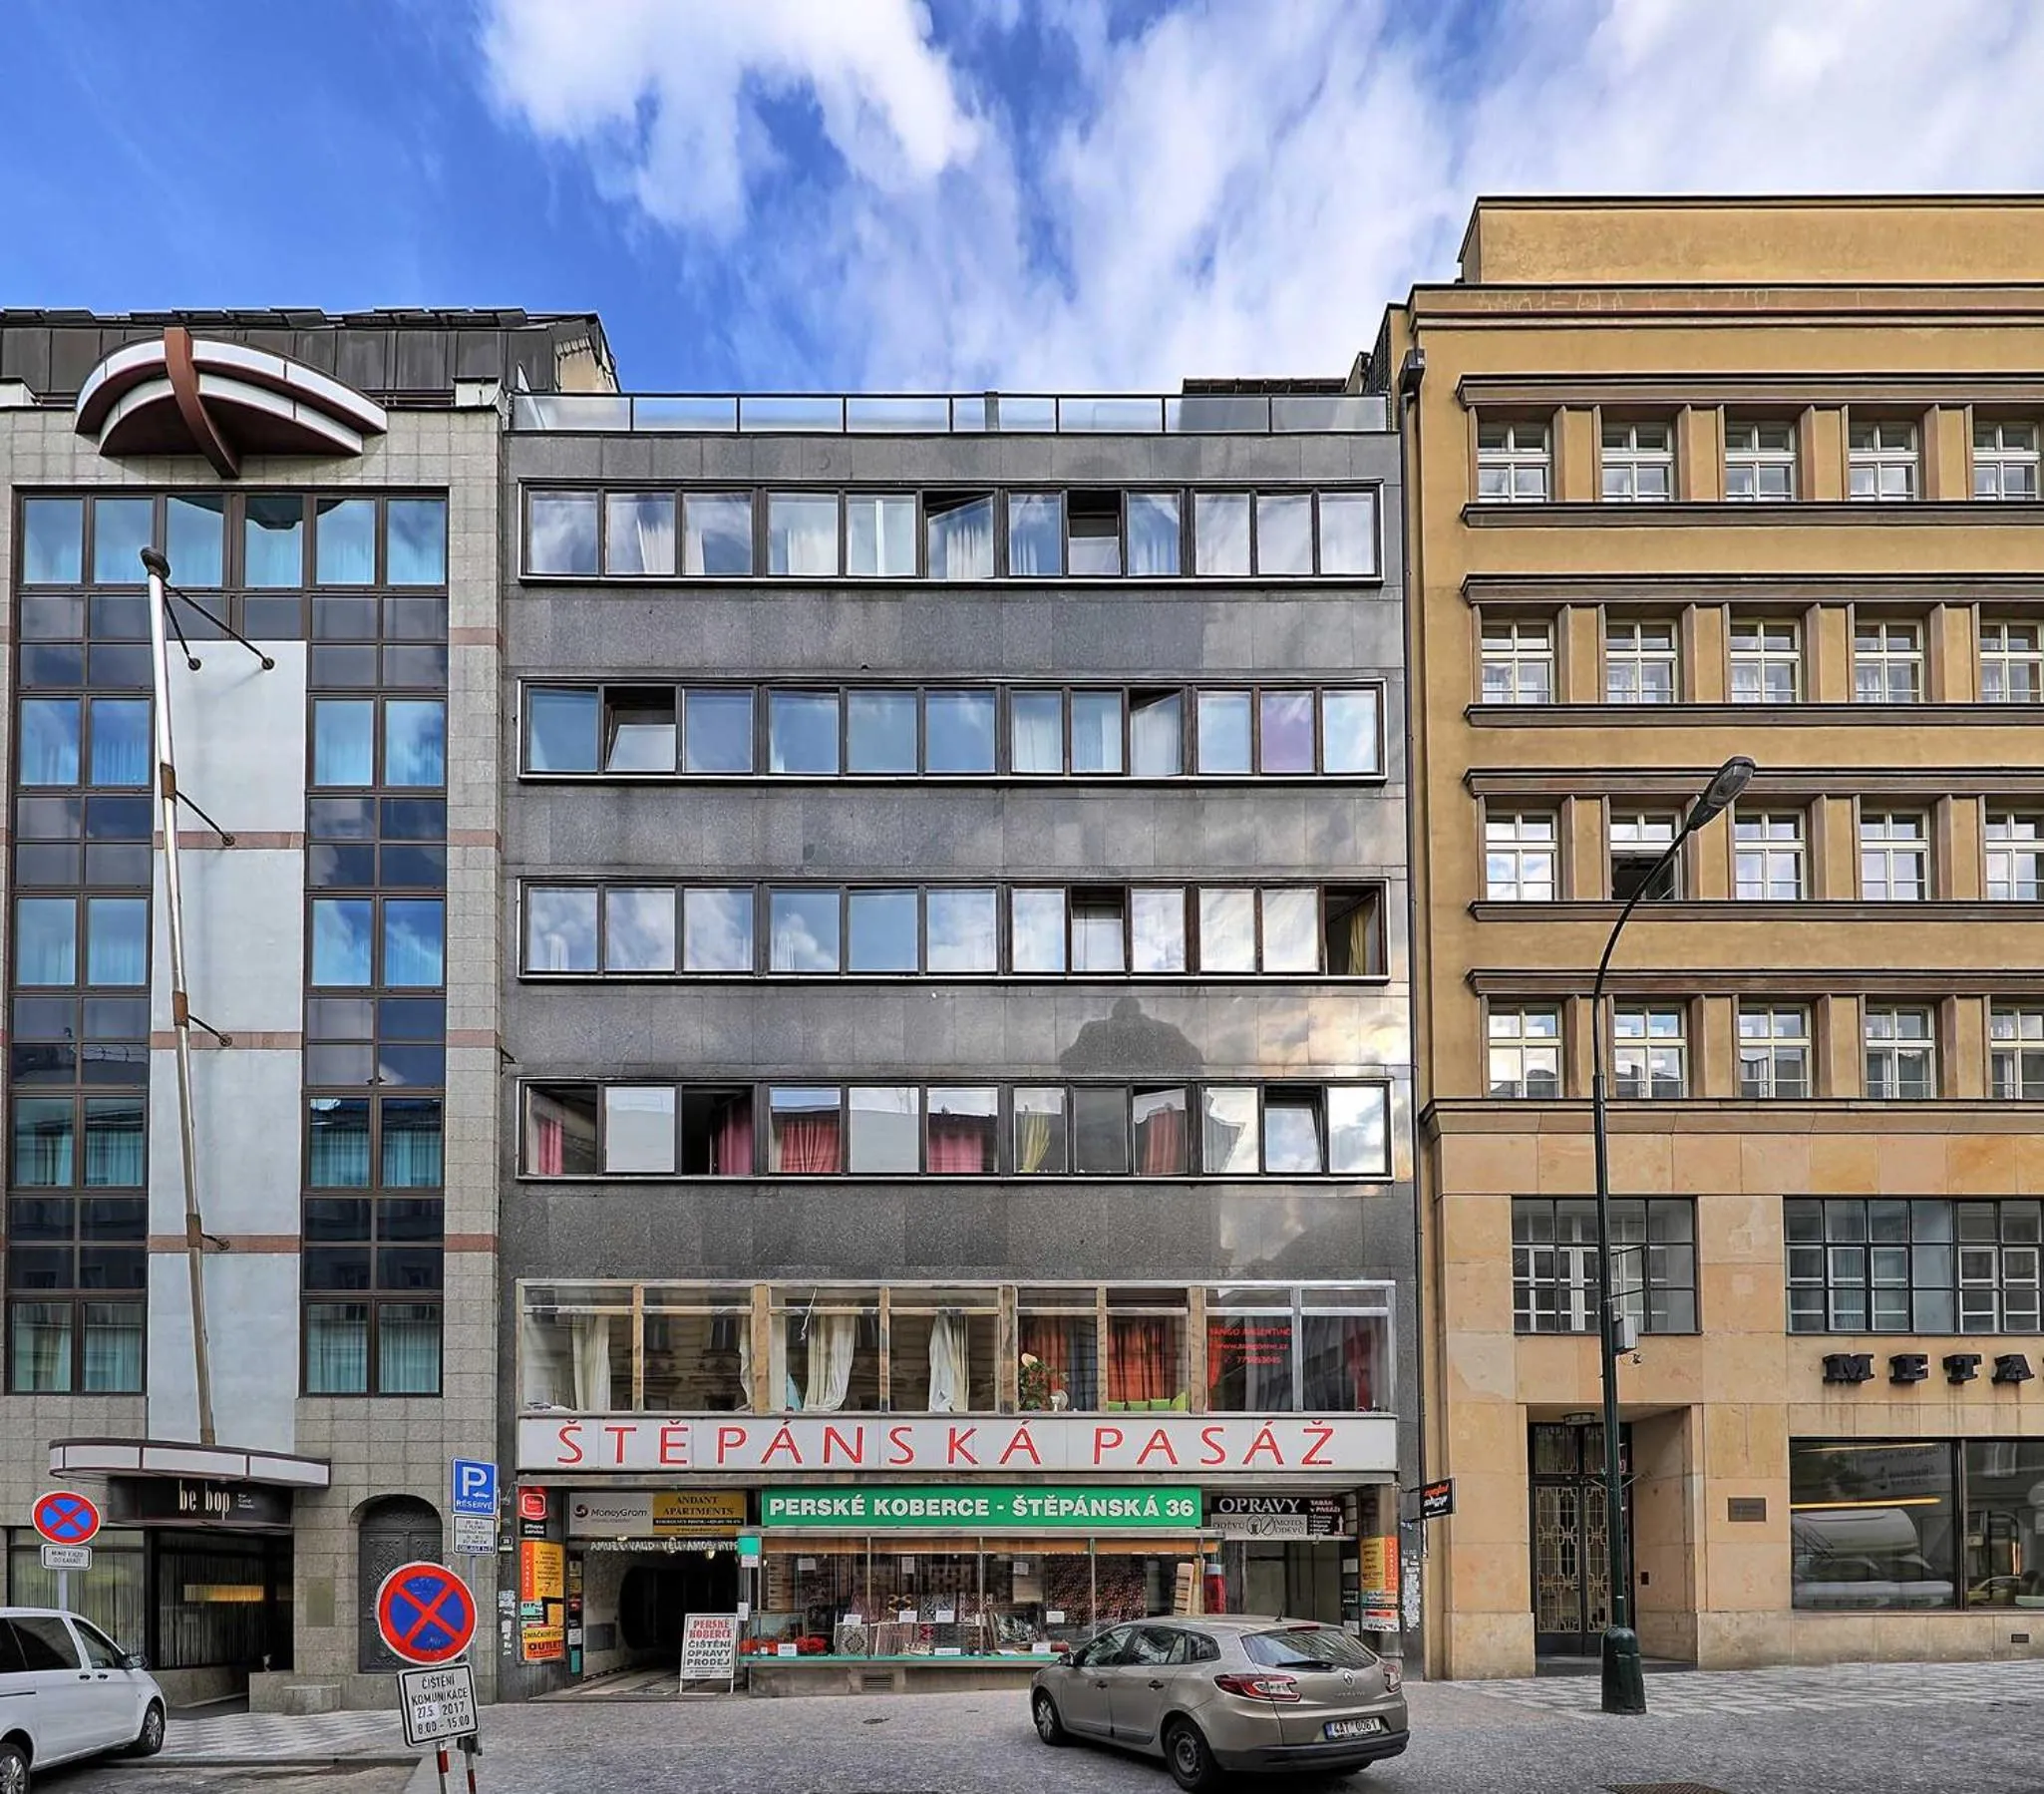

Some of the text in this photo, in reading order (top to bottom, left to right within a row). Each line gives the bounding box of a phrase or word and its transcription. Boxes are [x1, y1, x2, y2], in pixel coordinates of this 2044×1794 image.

[1823, 1354, 2044, 1384] META
[556, 1420, 1335, 1465] ŠTĚPÁNSKÁ PASÁŽ
[463, 1467, 488, 1497] P
[179, 1480, 230, 1521] be bop
[676, 1496, 719, 1505] ANDANT
[769, 1494, 866, 1517] PERSKÉ
[873, 1498, 990, 1517] KOBERCE
[1012, 1494, 1161, 1517] ŠTĚPÁNSKÁ
[1165, 1499, 1195, 1517] 36
[1218, 1497, 1300, 1513] OPRAVY
[590, 1508, 648, 1518] MoneyGram
[663, 1507, 735, 1516] APARTMENTS
[693, 1618, 730, 1628] PERSKÉ
[689, 1629, 732, 1638] KOBERCE
[688, 1639, 731, 1648] ČIŠTĚNÍ
[687, 1648, 731, 1657] OPRAVY
[411, 1687, 469, 1706] KOMUNIKACE
[442, 1701, 465, 1715] 2017
